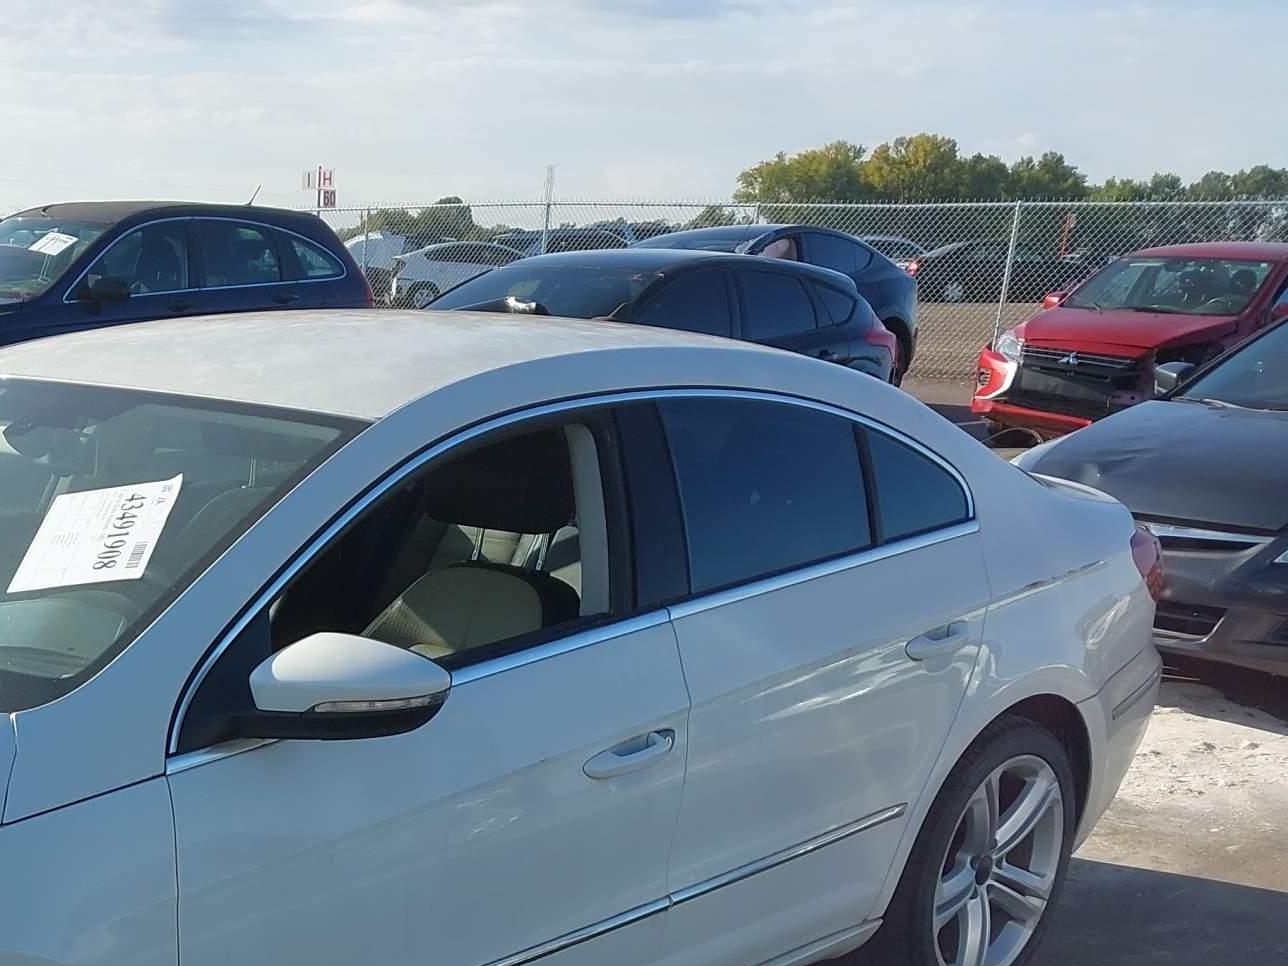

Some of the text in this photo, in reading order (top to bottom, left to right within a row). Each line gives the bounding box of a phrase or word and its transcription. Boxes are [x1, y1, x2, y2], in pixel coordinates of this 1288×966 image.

[322, 170, 333, 186] H
[323, 190, 336, 206] 60
[92, 493, 147, 570] 43491908
